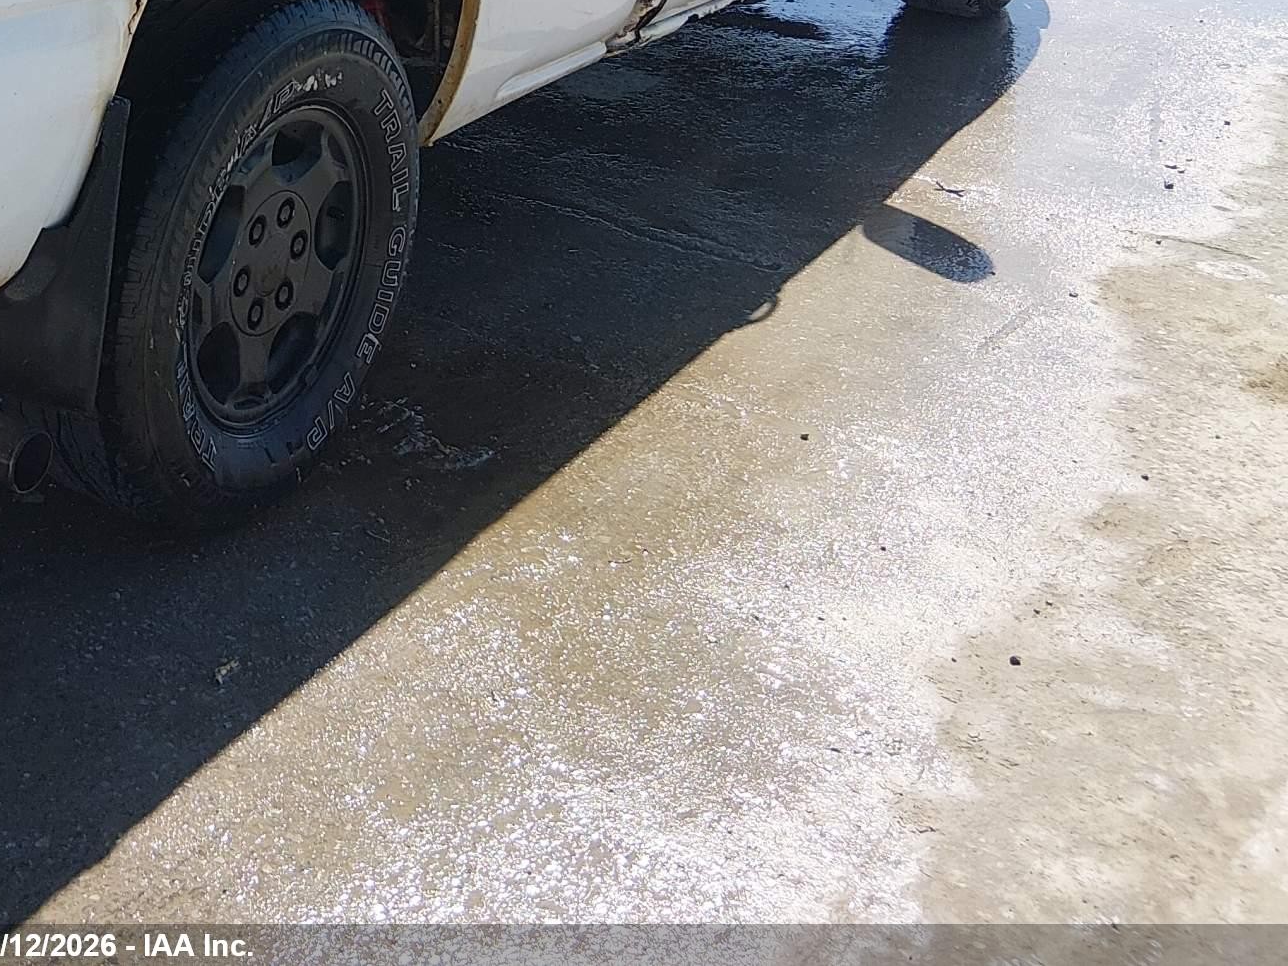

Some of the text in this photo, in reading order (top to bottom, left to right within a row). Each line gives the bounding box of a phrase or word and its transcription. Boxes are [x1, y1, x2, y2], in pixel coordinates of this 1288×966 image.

[305, 88, 410, 452] TRAIL GUIDE A/P
